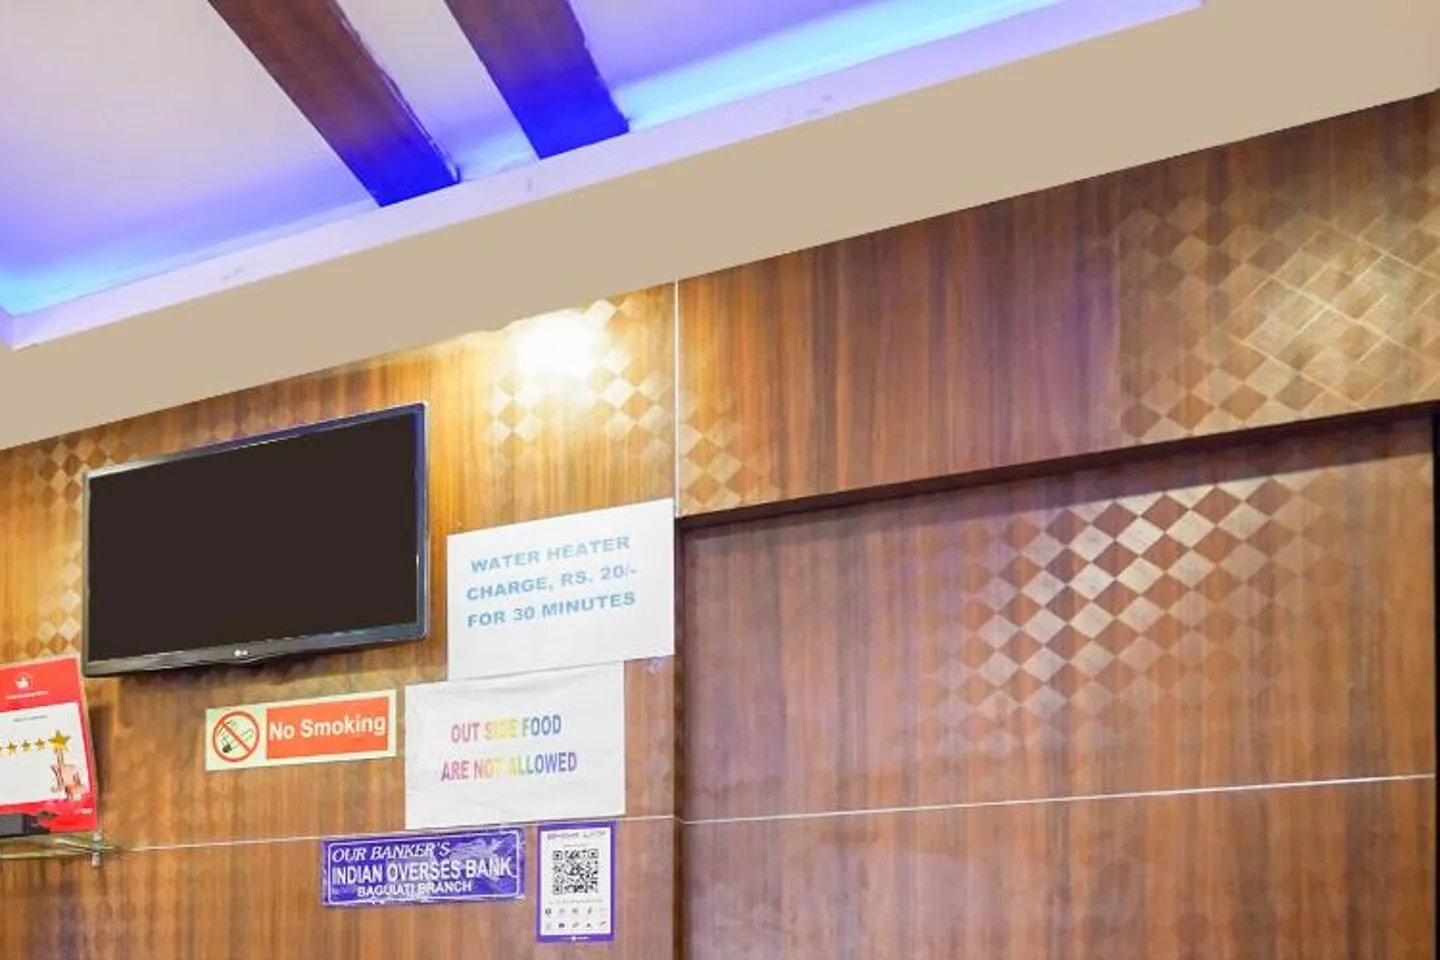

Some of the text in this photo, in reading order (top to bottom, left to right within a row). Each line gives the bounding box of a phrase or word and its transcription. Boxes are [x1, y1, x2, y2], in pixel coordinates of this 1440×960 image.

[471, 536, 631, 574] WATER HEATER
[467, 591, 637, 628] FOR 30 MINUTES
[269, 714, 386, 741] No Smoking
[450, 714, 561, 743] OUT SIDE FOOD
[441, 752, 577, 782] ARE NOT ALLOWED
[332, 841, 452, 862] OUR BANKER'S
[331, 857, 513, 885] INDIAN OVERSES BANK
[418, 880, 473, 896] BRANCH
